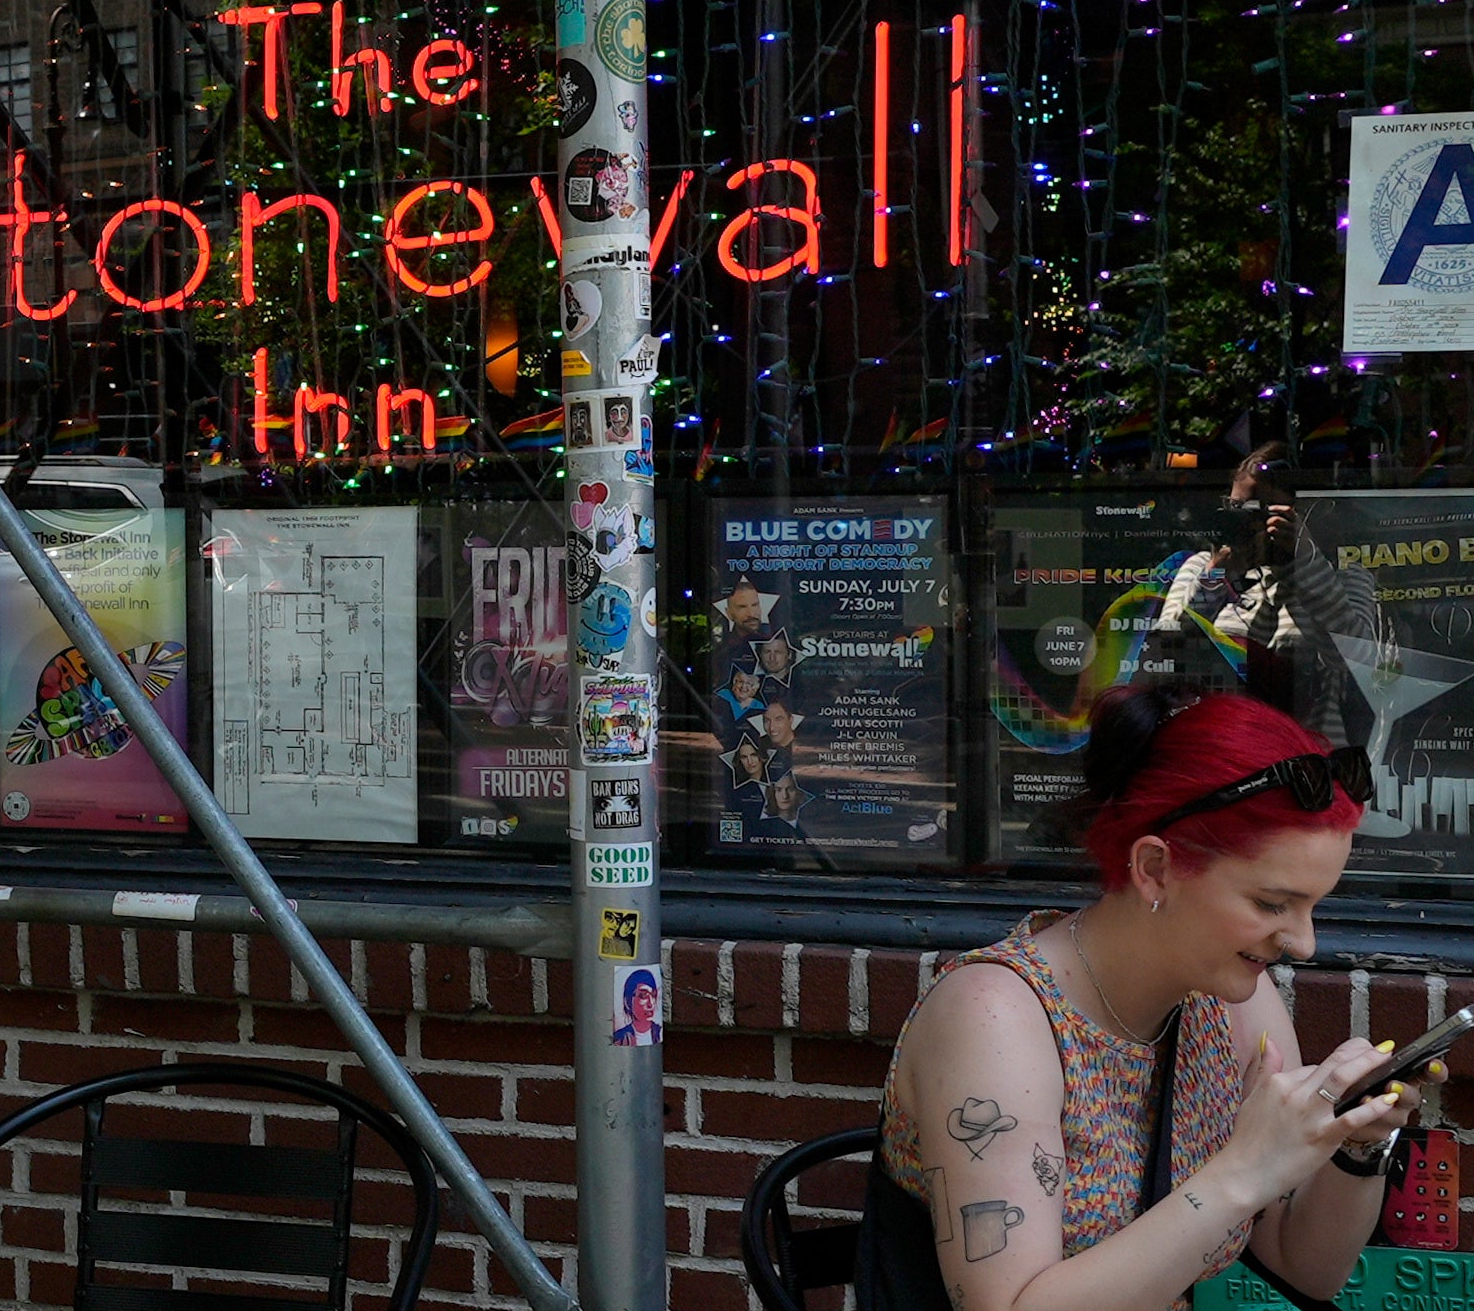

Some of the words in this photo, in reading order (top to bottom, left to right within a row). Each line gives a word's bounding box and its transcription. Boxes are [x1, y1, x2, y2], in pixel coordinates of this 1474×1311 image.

[217, 0, 478, 123] The
[1372, 123, 1427, 134] SANITARY
[253, 346, 438, 463] Inn
[1095, 506, 1152, 516] Stonewall
[725, 520, 799, 541] BLUE
[131, 532, 151, 543] Inn
[65, 548, 98, 560] Back
[102, 548, 159, 560] Initiative
[746, 544, 760, 558] A
[762, 544, 812, 557] NIGHT
[814, 544, 837, 557] OF
[839, 543, 919, 557] STANDUP
[1337, 539, 1450, 570] PIANO
[726, 559, 751, 572] TO
[752, 558, 826, 571] SUPPORT
[828, 557, 933, 571] DEMOCRACY
[104, 565, 130, 576] and
[133, 566, 161, 579] only
[1013, 568, 1098, 585] PRIDE
[119, 581, 133, 593] of
[798, 580, 873, 596] SUNDAY,
[877, 580, 919, 593] JULY
[925, 579, 936, 593] 7
[1372, 587, 1442, 602] SECOND
[838, 598, 895, 611] 7:30PM
[832, 630, 878, 639] UPSTAIRS
[879, 630, 889, 639] AT
[1055, 626, 1075, 636] FRI
[801, 637, 920, 657] Stonewall
[1045, 642, 1076, 651] JUNE
[1077, 642, 1085, 651] 7
[1049, 658, 1081, 667] 10PM
[1119, 660, 1139, 673] DJ
[834, 696, 867, 705] ADAM
[870, 696, 900, 705] SANK
[818, 708, 848, 717] JOHN
[851, 708, 917, 717] FUGELSANG
[831, 719, 862, 728] JULIA
[864, 719, 903, 728] SCOTTI
[855, 731, 898, 740] CAUVIN
[829, 742, 862, 751] IRENE
[864, 742, 905, 752] BREMIS
[1413, 740, 1447, 750] SINGING
[1450, 740, 1470, 750] WAIT
[818, 753, 850, 762] MILES
[853, 753, 918, 764] WHITTAKER
[480, 769, 566, 798] FRIDAYS
[592, 780, 612, 796] BAN
[614, 780, 640, 796] GUNS
[841, 802, 893, 815] ActBlue
[594, 811, 615, 827] NOT
[615, 810, 640, 826] DRAG
[588, 847, 650, 864] GOOD
[590, 867, 649, 884] SEED
[1226, 1278, 1284, 1306] FIRE
